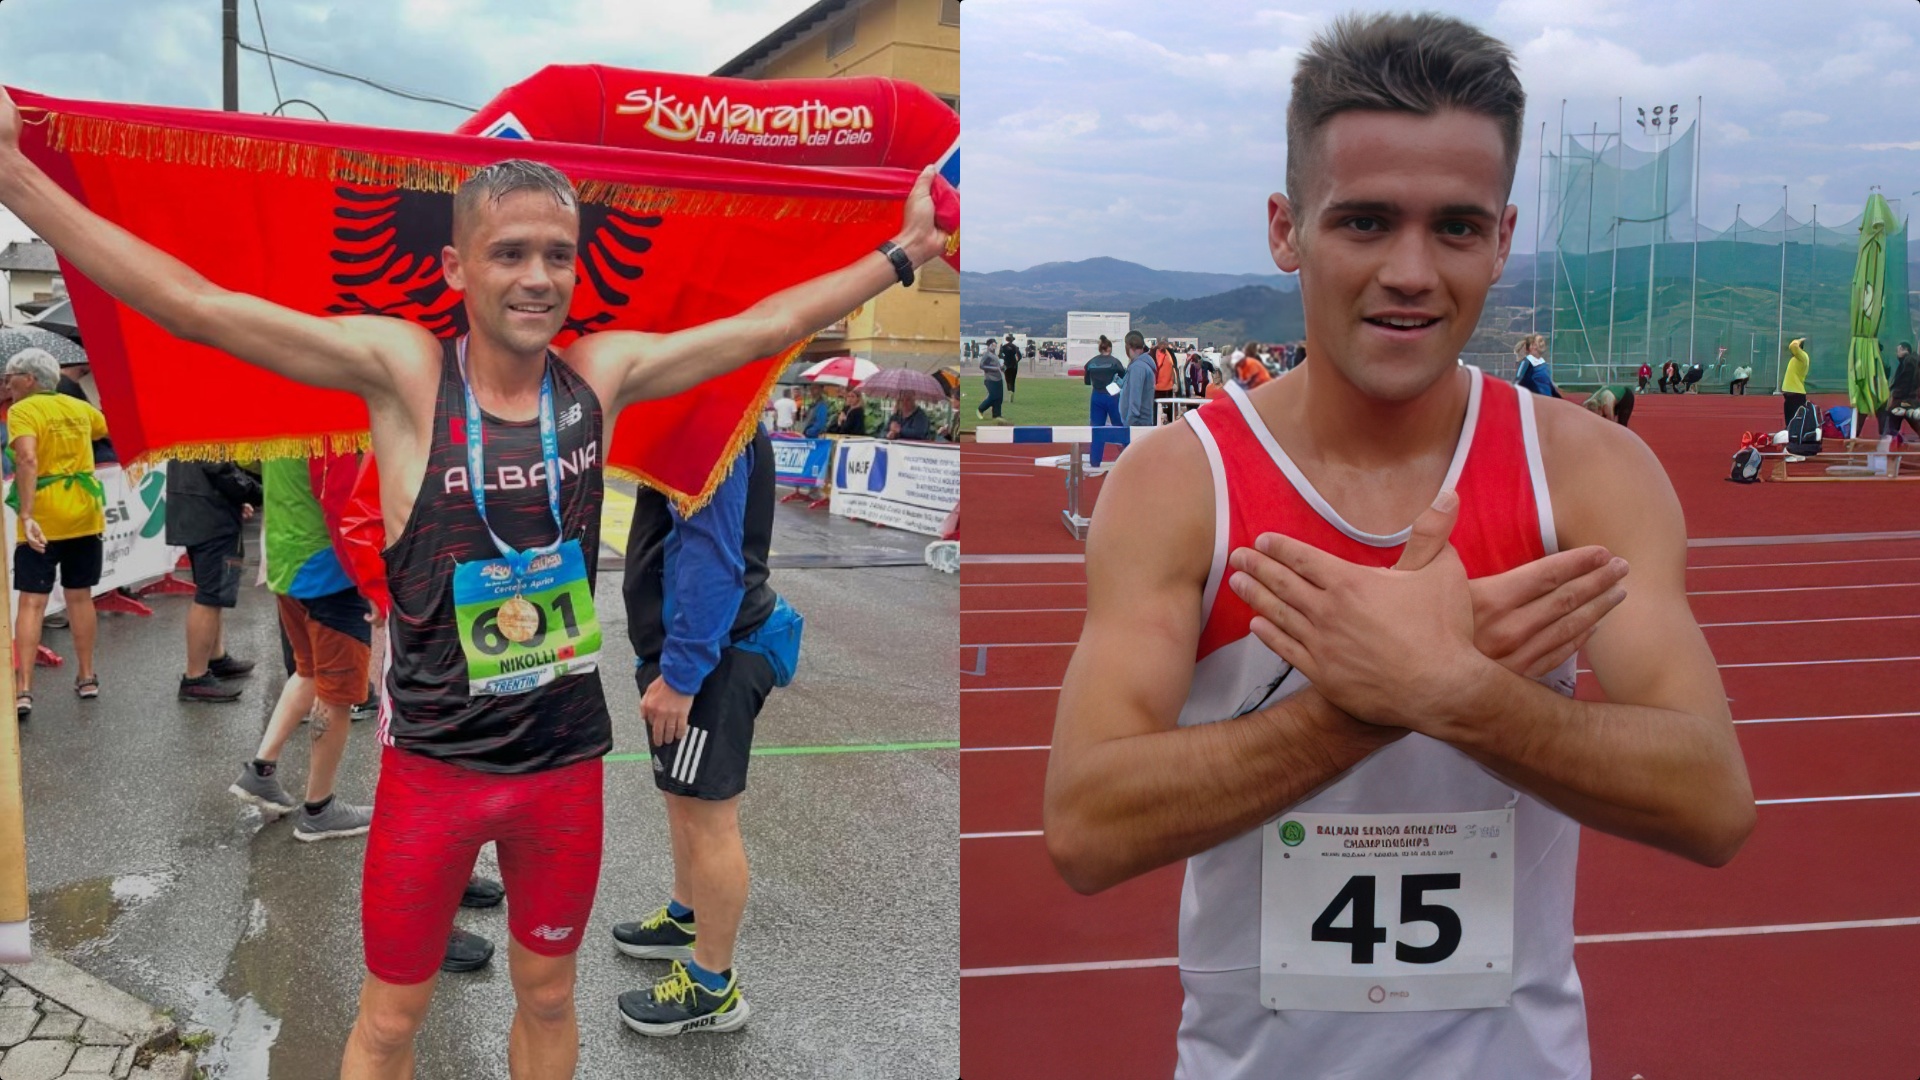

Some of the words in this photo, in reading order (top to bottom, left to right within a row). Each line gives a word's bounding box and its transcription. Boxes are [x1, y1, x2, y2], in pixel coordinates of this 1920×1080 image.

[695, 126, 716, 142] La
[719, 128, 798, 147] Maratona
[806, 130, 832, 146] del
[834, 129, 872, 146] Cielo
[500, 648, 557, 674] NIKOLLI
[1312, 873, 1462, 964] 45
